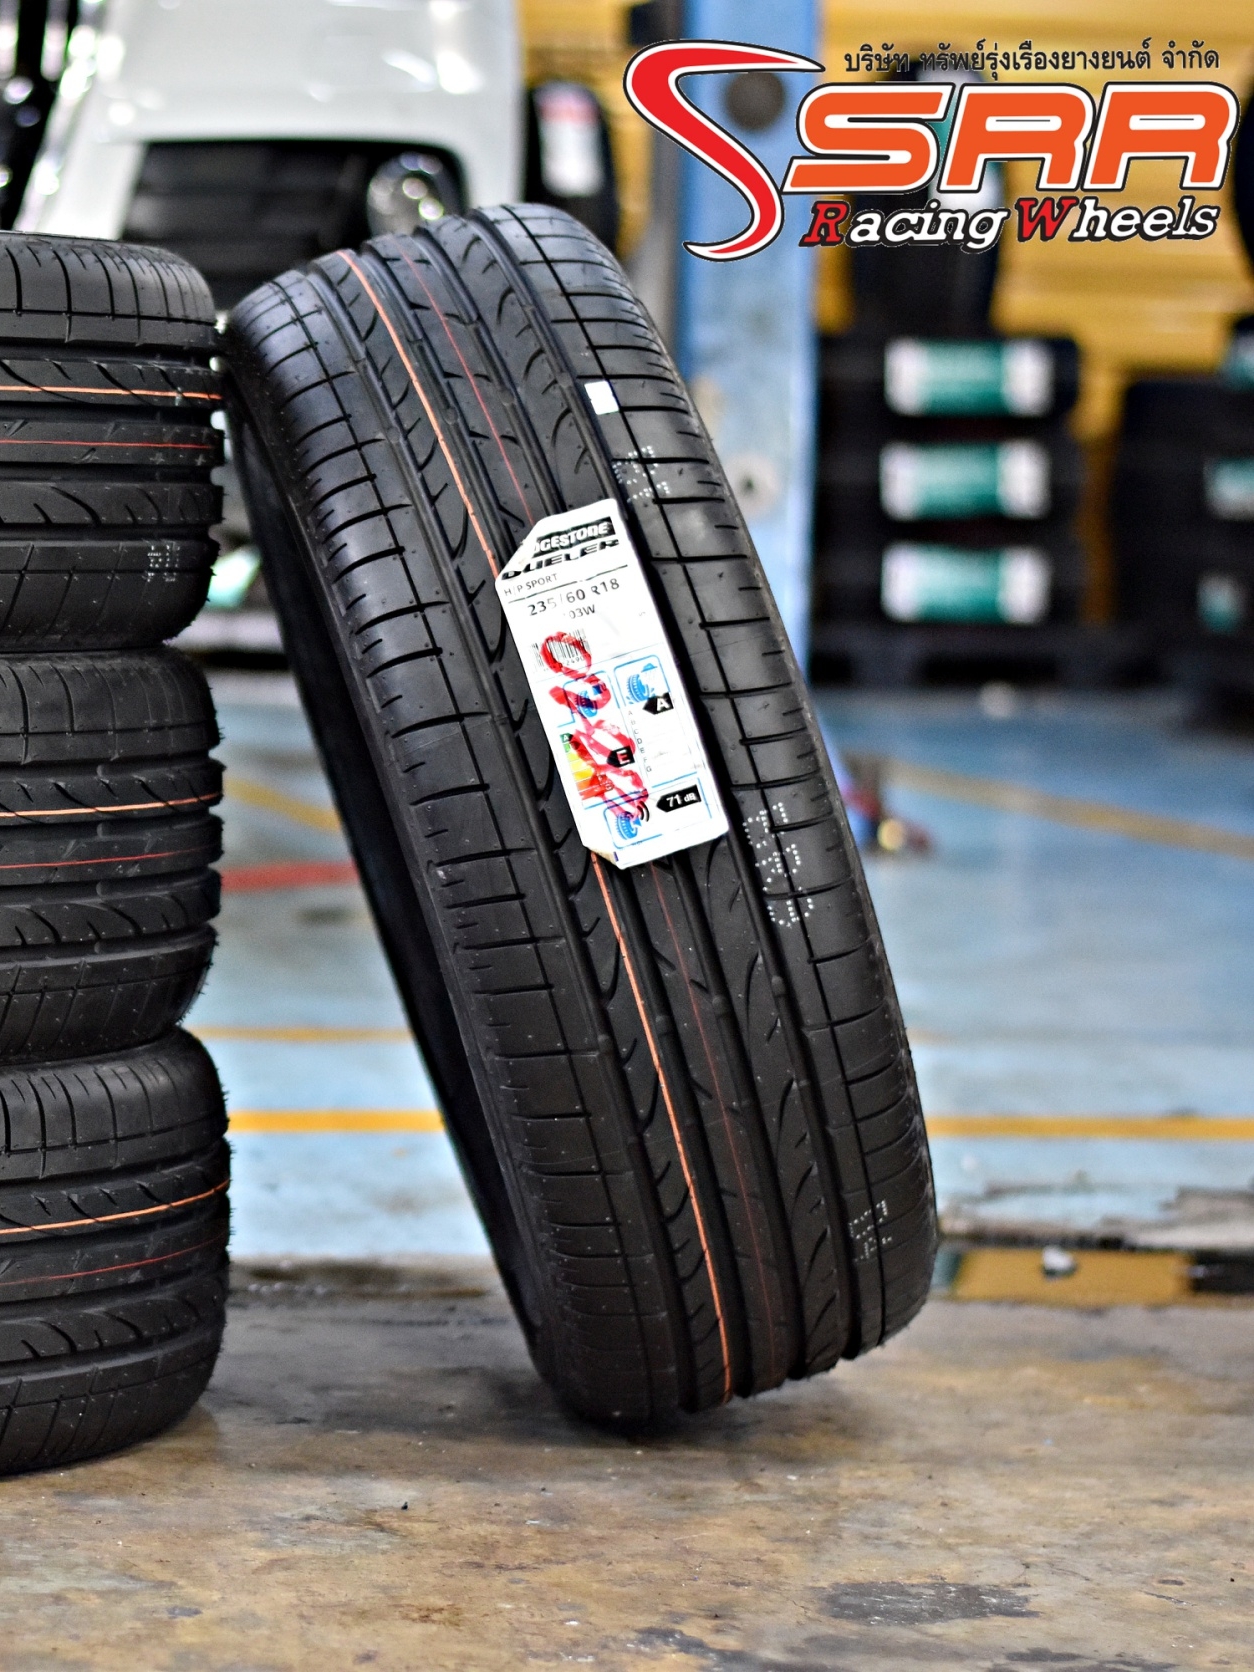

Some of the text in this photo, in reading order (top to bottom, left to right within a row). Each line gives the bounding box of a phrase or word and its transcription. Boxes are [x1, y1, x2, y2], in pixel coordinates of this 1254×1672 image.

[525, 573, 558, 591] SPORT
[527, 577, 620, 617] 235/60 R18
[563, 603, 596, 620] 03W
[656, 698, 670, 712] A
[666, 792, 697, 808] 71 dB
